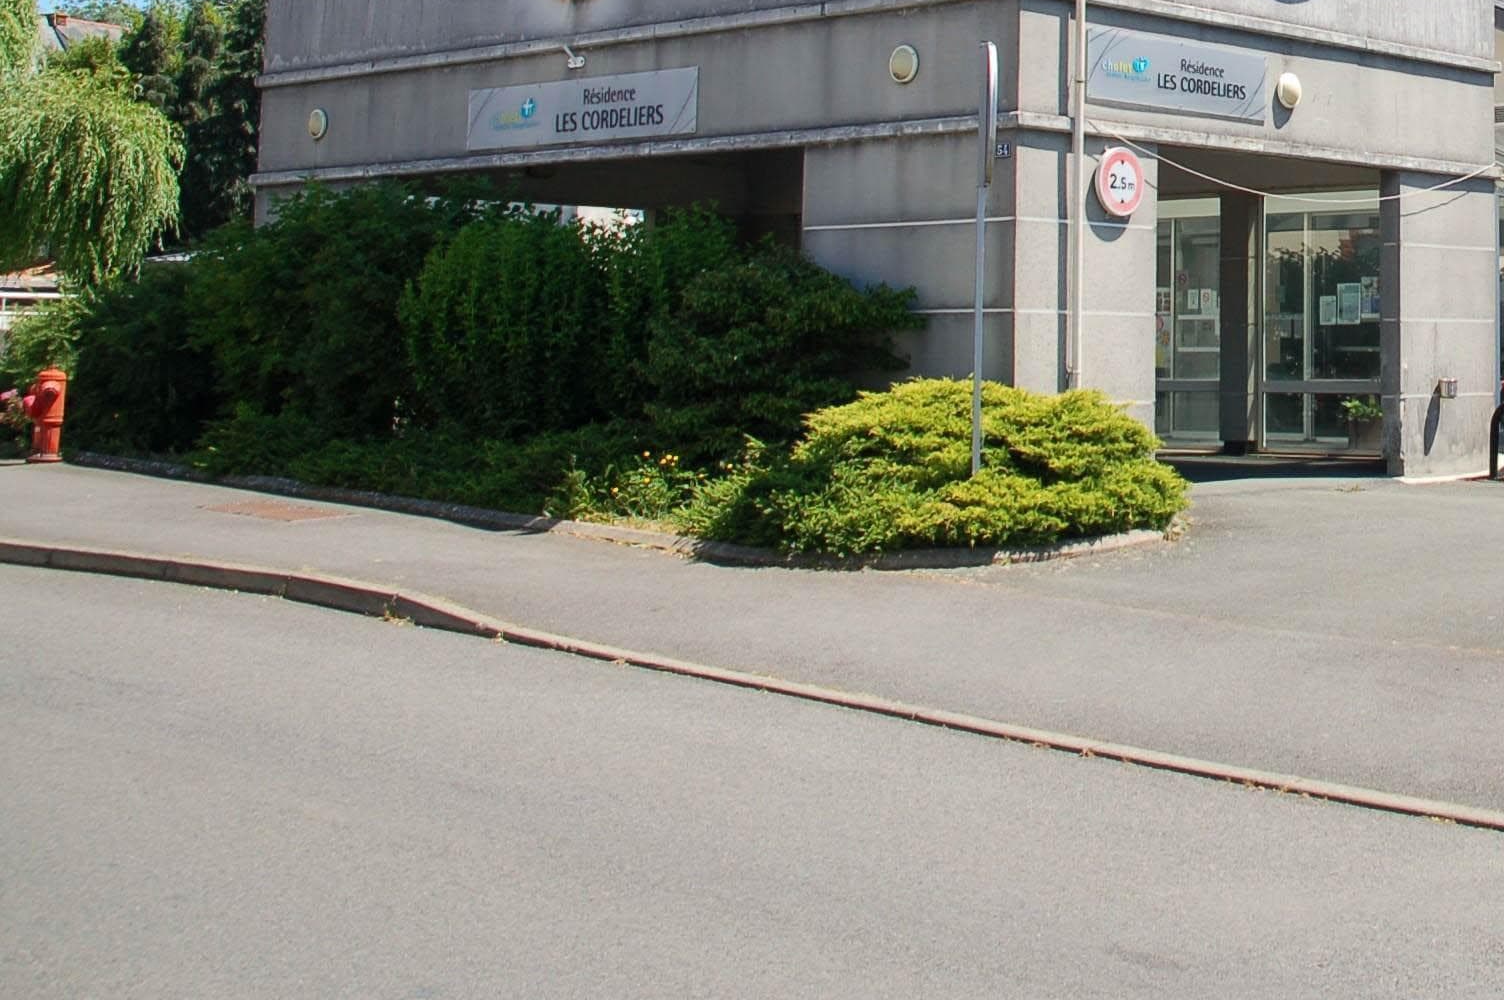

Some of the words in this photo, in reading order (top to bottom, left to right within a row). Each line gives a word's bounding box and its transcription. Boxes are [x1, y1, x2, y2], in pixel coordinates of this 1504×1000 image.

[1180, 57, 1224, 78] Résidence
[583, 86, 636, 105] Résidence
[1157, 73, 1177, 90] LES
[1180, 76, 1246, 100] CORDELIERS
[555, 112, 577, 133] LES
[582, 104, 664, 131] CORDELIERS
